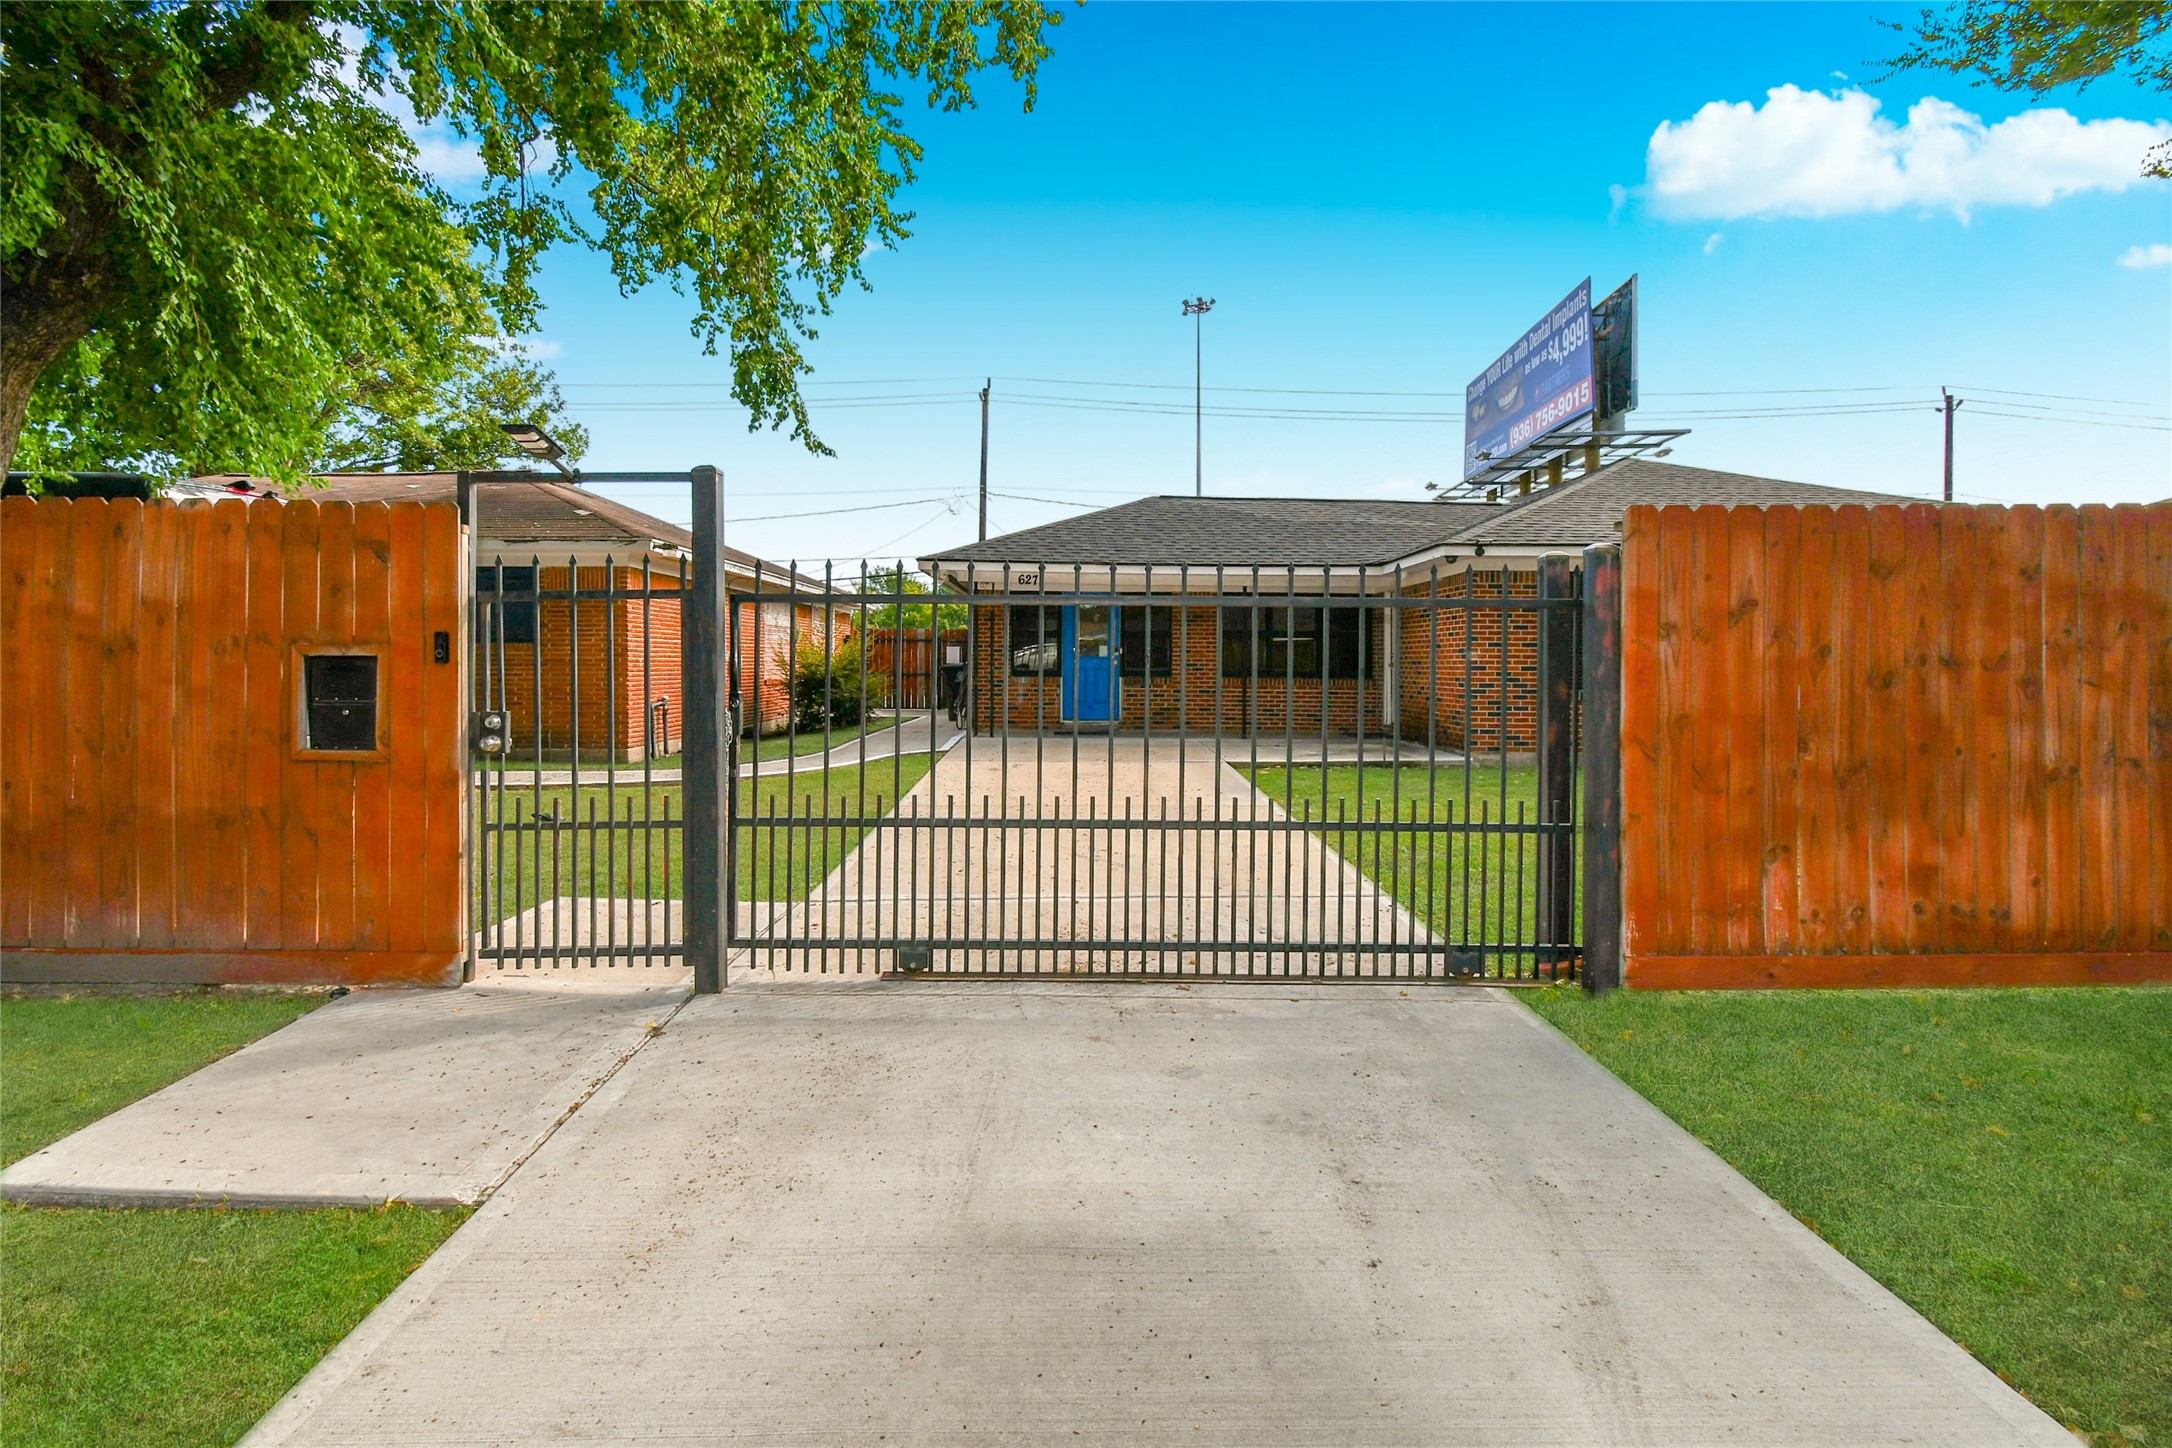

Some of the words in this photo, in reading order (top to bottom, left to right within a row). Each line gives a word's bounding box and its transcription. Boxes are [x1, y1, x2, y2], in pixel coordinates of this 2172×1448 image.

[1468, 378, 1486, 402] Change
[1487, 361, 1501, 387] YOUR
[1502, 353, 1513, 374] Life
[1514, 339, 1528, 364] with
[1529, 317, 1551, 352] Dental
[1552, 289, 1587, 332] Implants
[1548, 311, 1589, 366] $4,999!
[1510, 415, 1533, 448] (936)
[1536, 382, 1590, 430] 756-9015
[1018, 574, 1039, 586] 627
